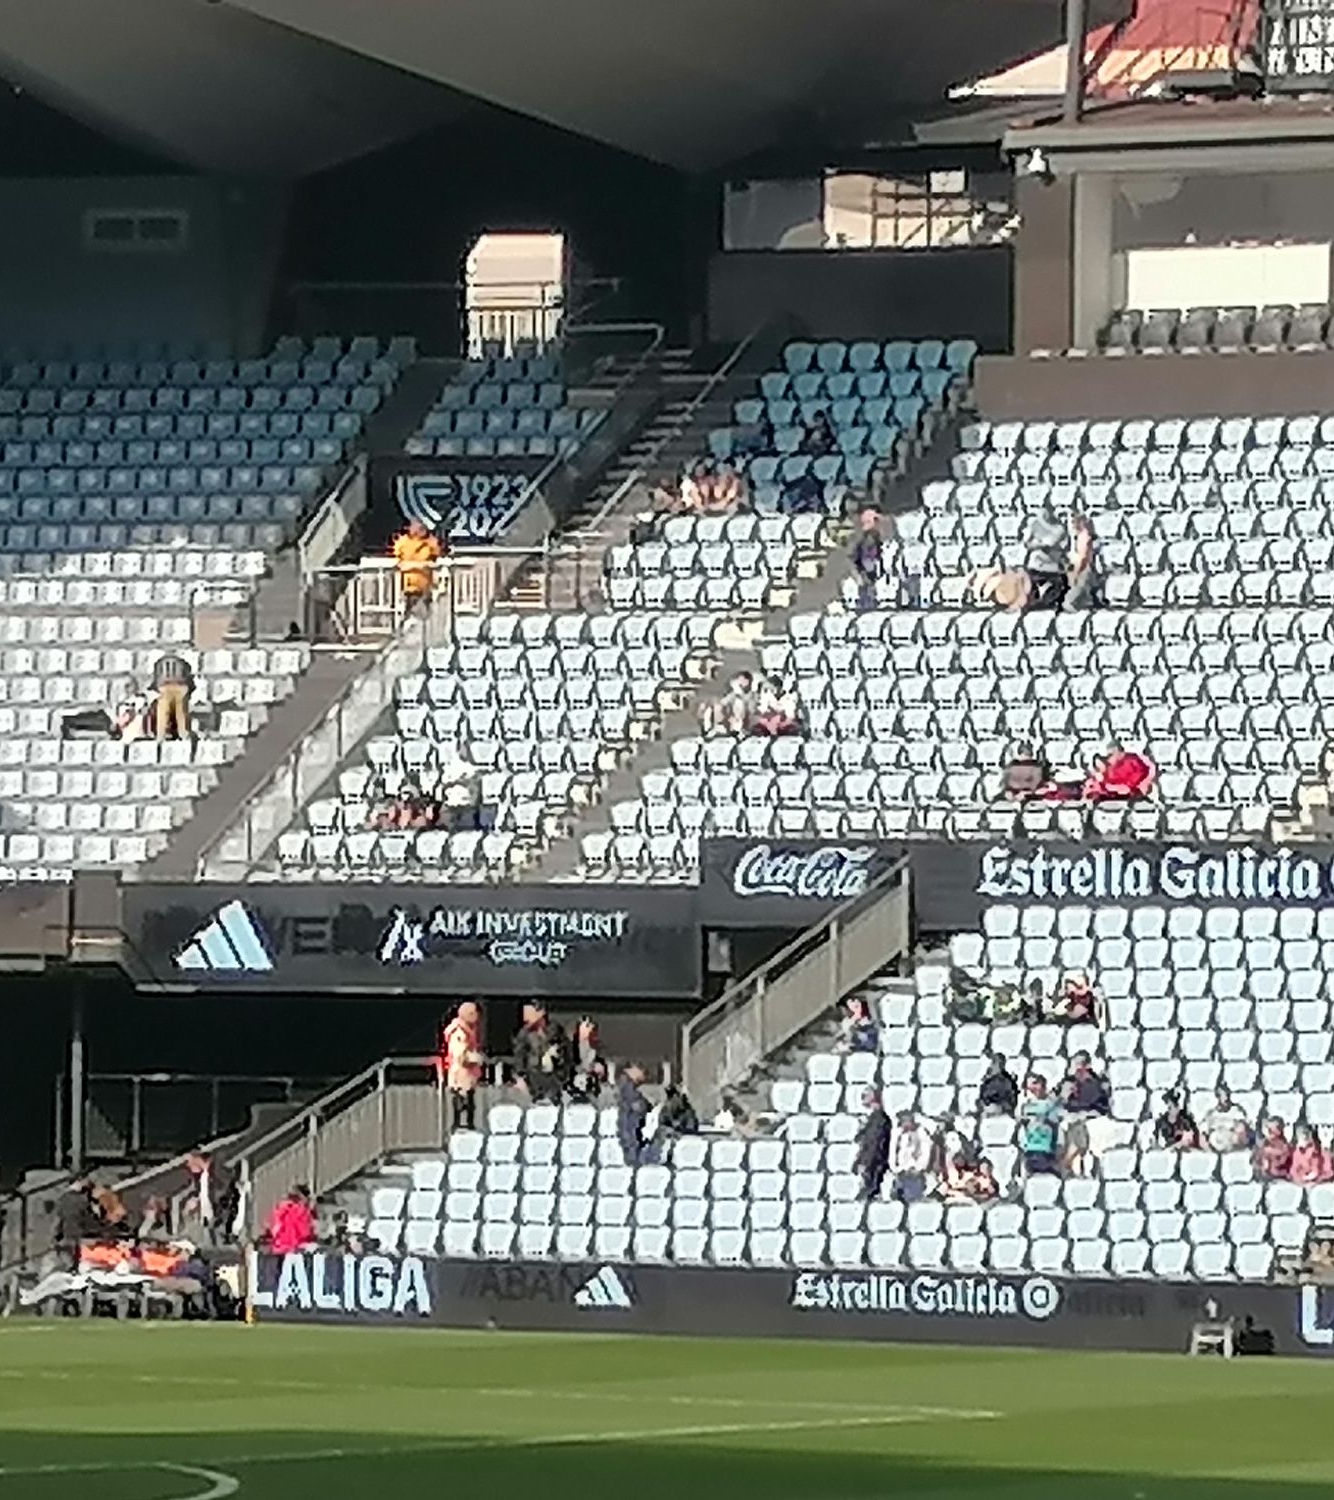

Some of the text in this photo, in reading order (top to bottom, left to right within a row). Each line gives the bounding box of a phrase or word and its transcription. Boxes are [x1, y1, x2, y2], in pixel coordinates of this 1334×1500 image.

[978, 846, 1323, 899] Estrella Galicia
[250, 1252, 432, 1317] LALIGA
[792, 1274, 1016, 1314] Estrella Galicia
